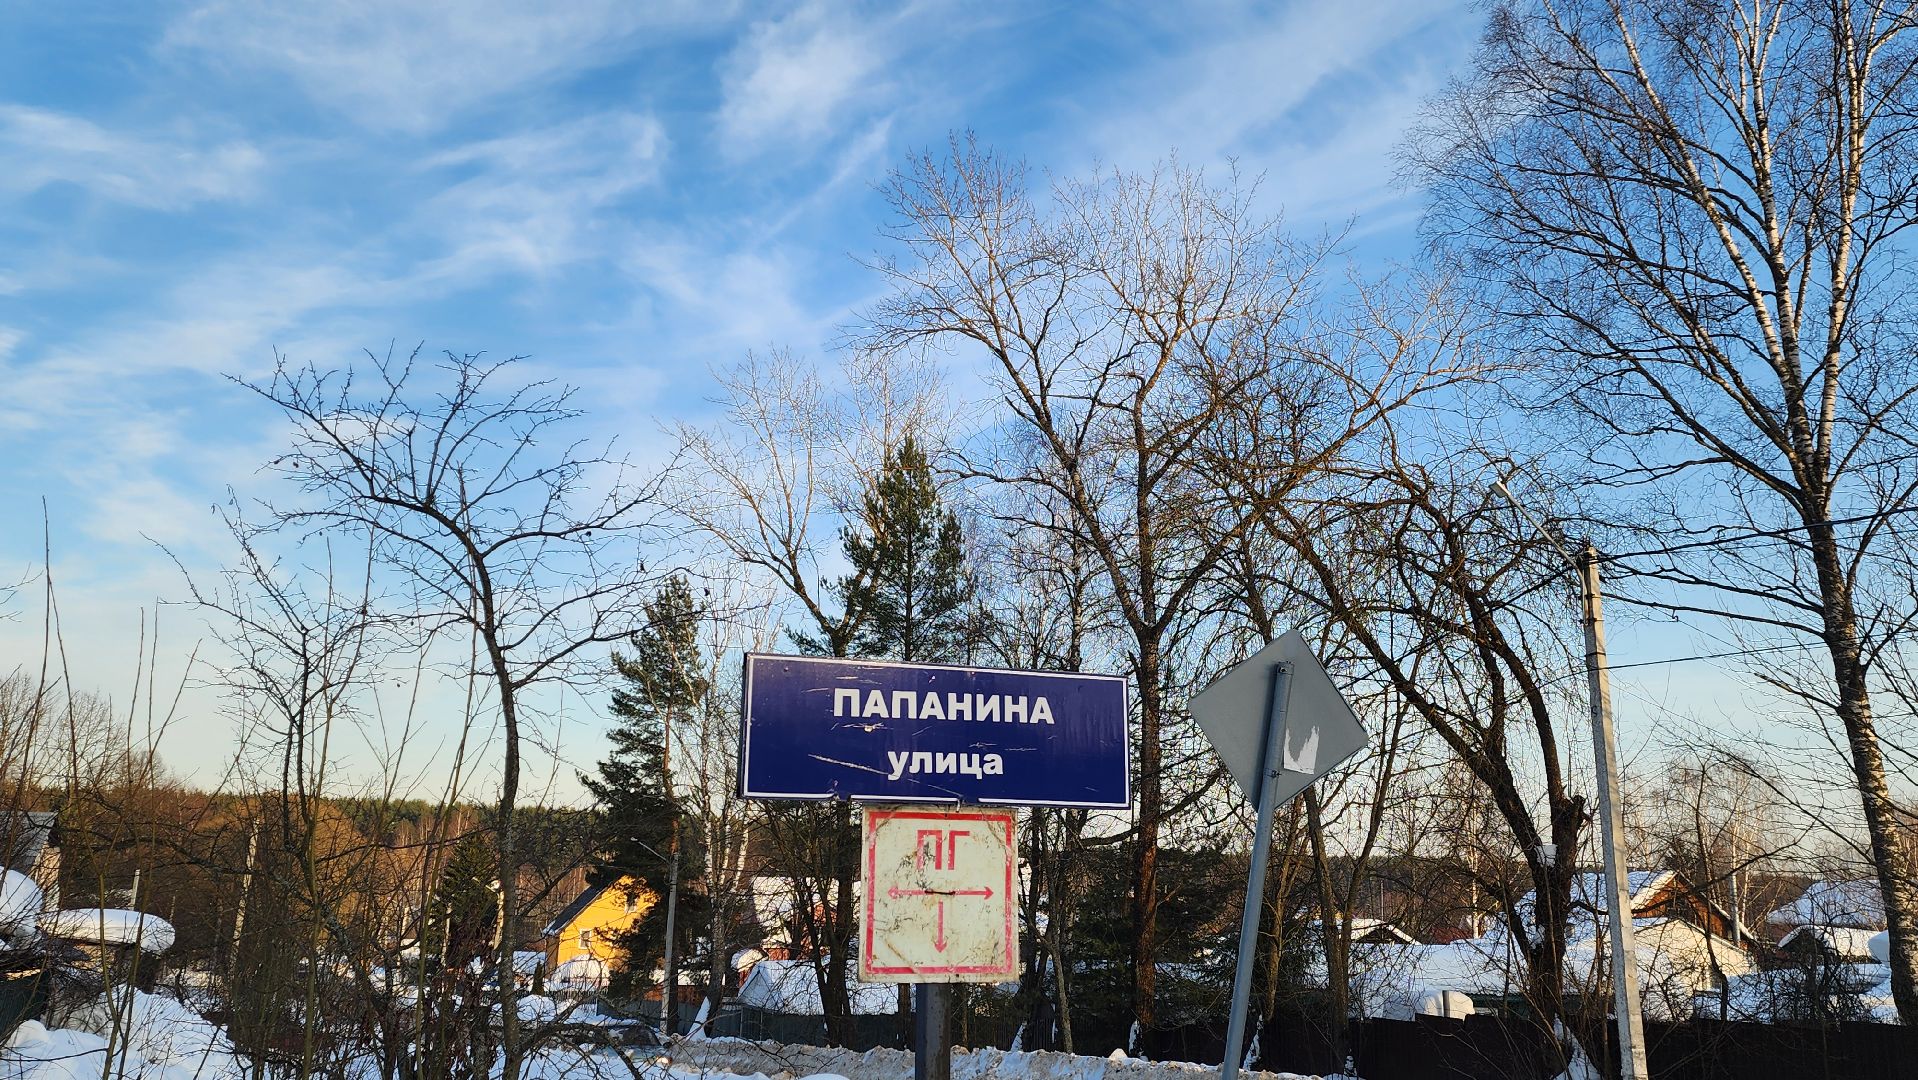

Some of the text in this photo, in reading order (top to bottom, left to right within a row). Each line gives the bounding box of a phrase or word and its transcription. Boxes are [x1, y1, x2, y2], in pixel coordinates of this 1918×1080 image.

[833, 688, 1055, 725] ПАПАНИНА
[887, 750, 1004, 781] улица
[916, 829, 970, 871] ПГ
